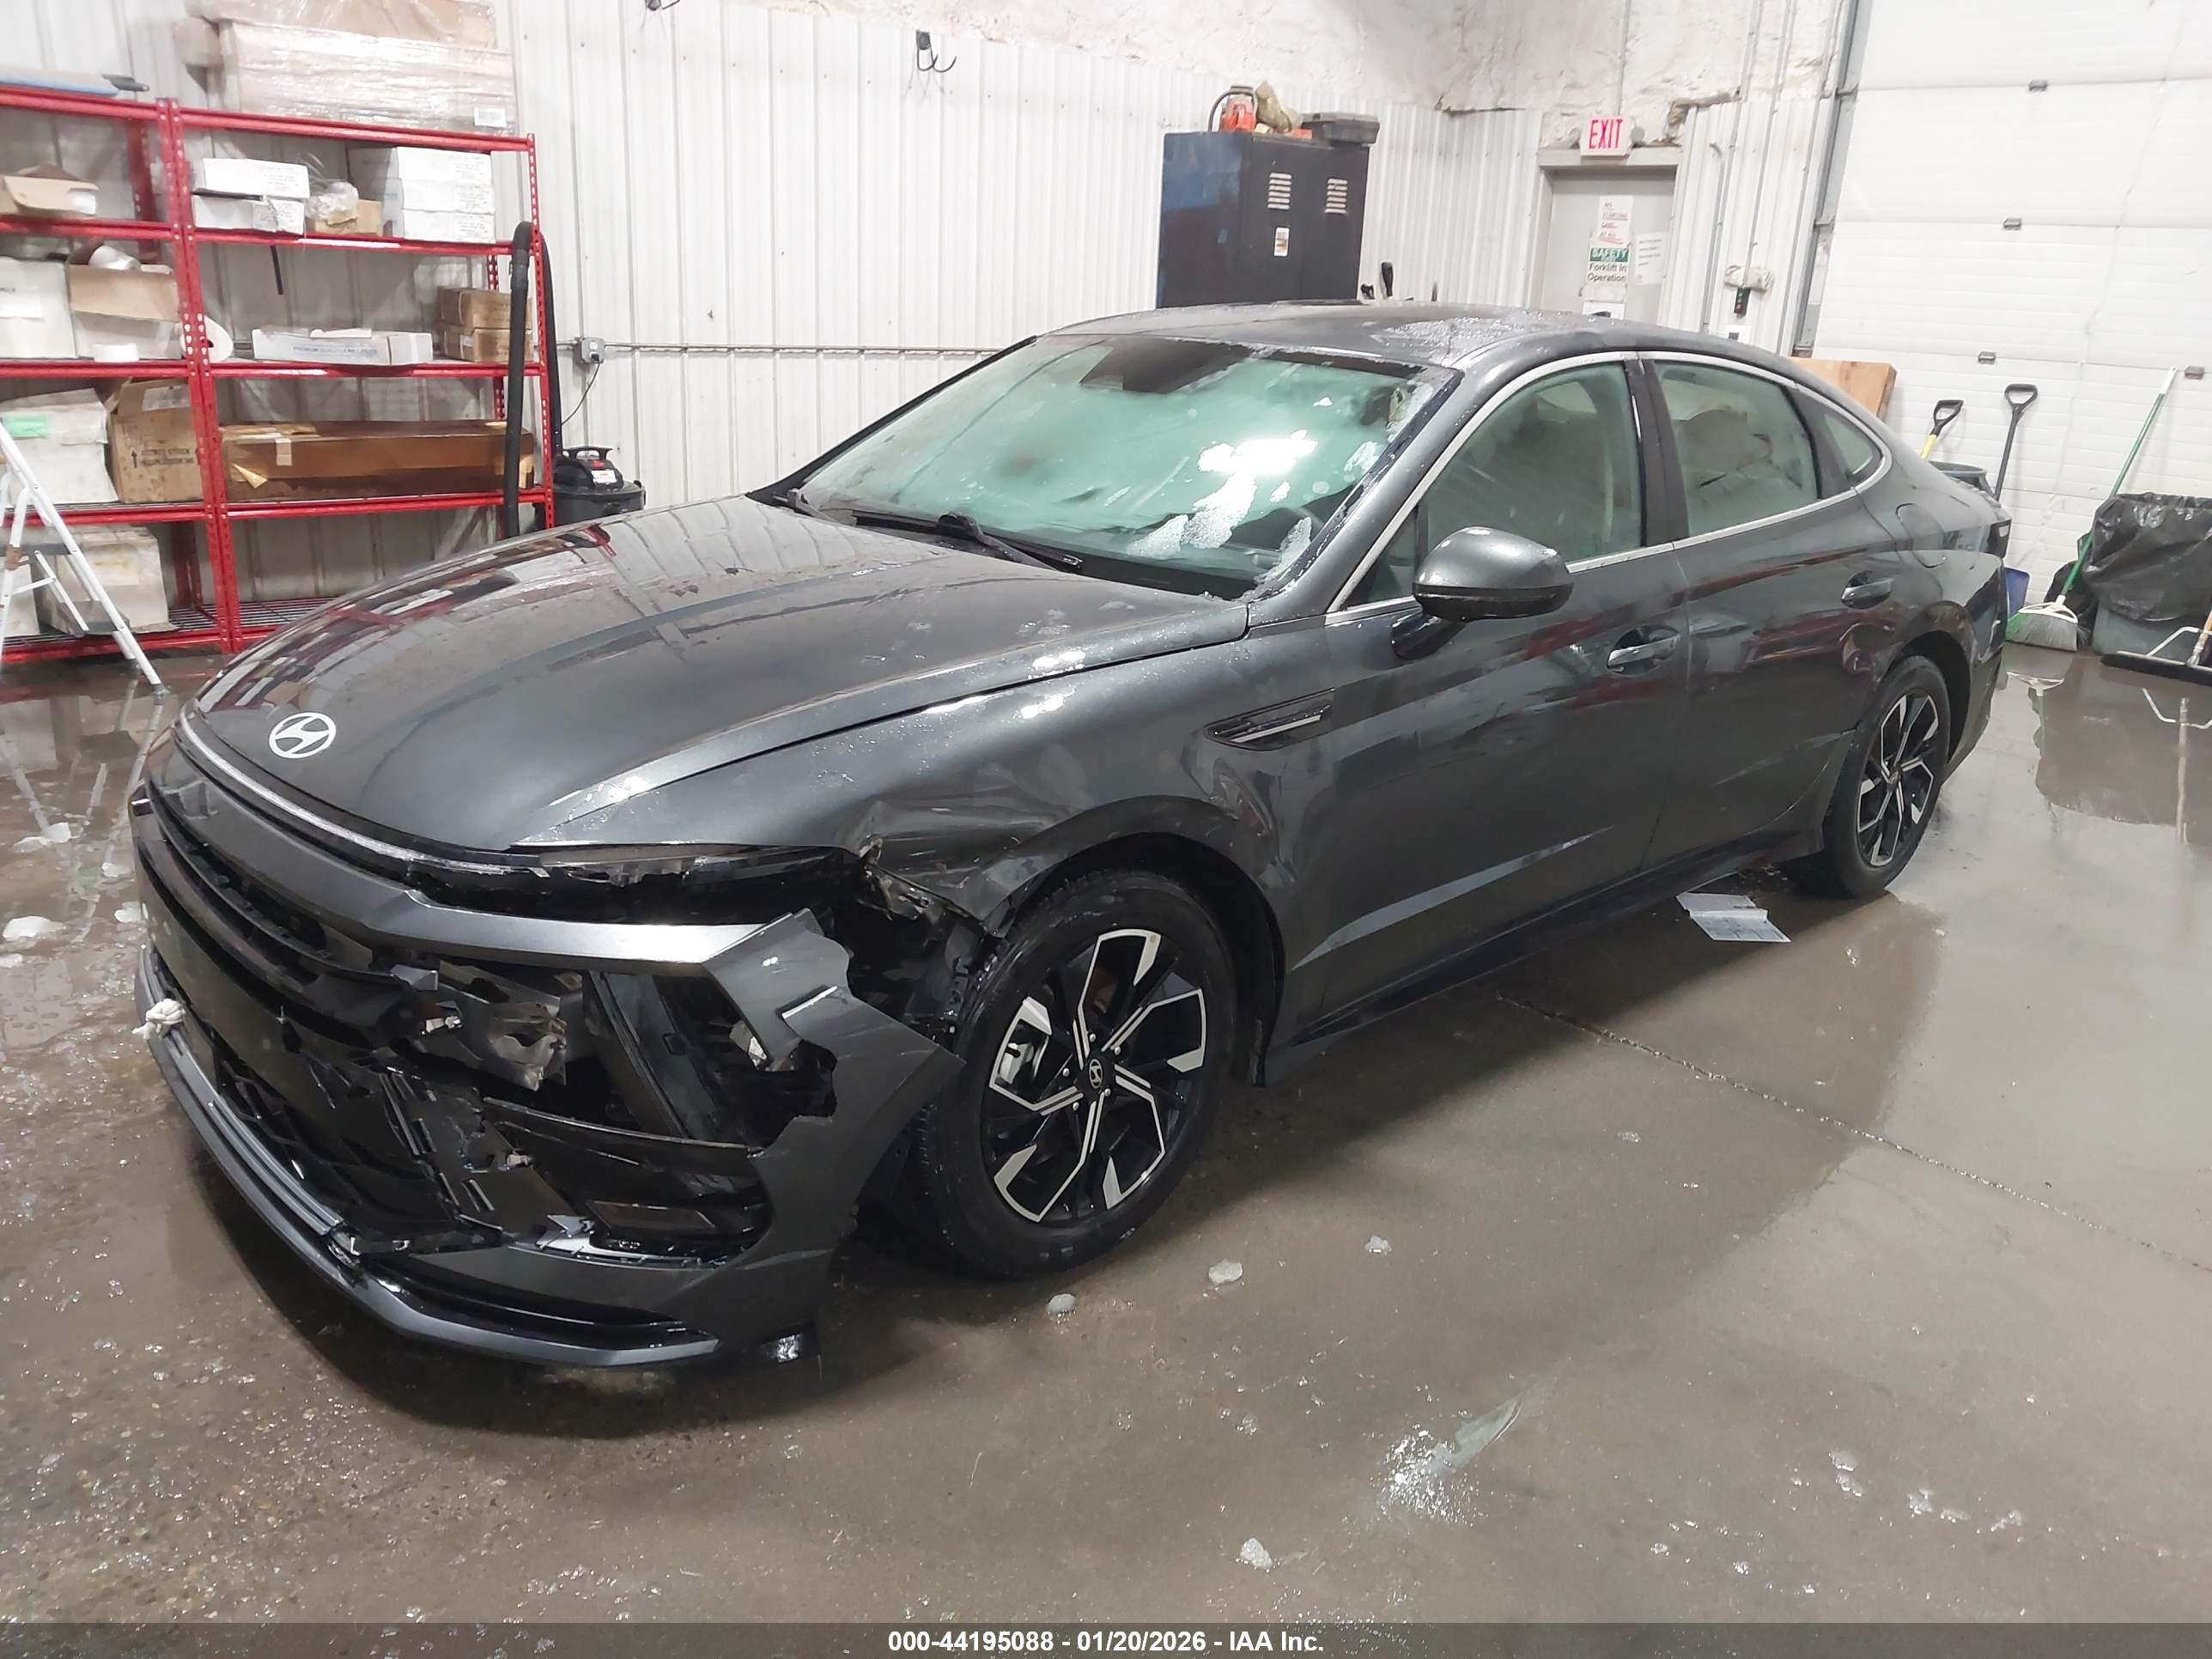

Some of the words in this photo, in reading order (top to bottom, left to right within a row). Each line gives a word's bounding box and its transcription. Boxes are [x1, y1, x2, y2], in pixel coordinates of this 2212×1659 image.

[1589, 118, 1624, 149] EXIT
[1592, 247, 1628, 258] SAFETY
[1589, 262, 1618, 272] Forklift
[1587, 272, 1627, 283] Operation
